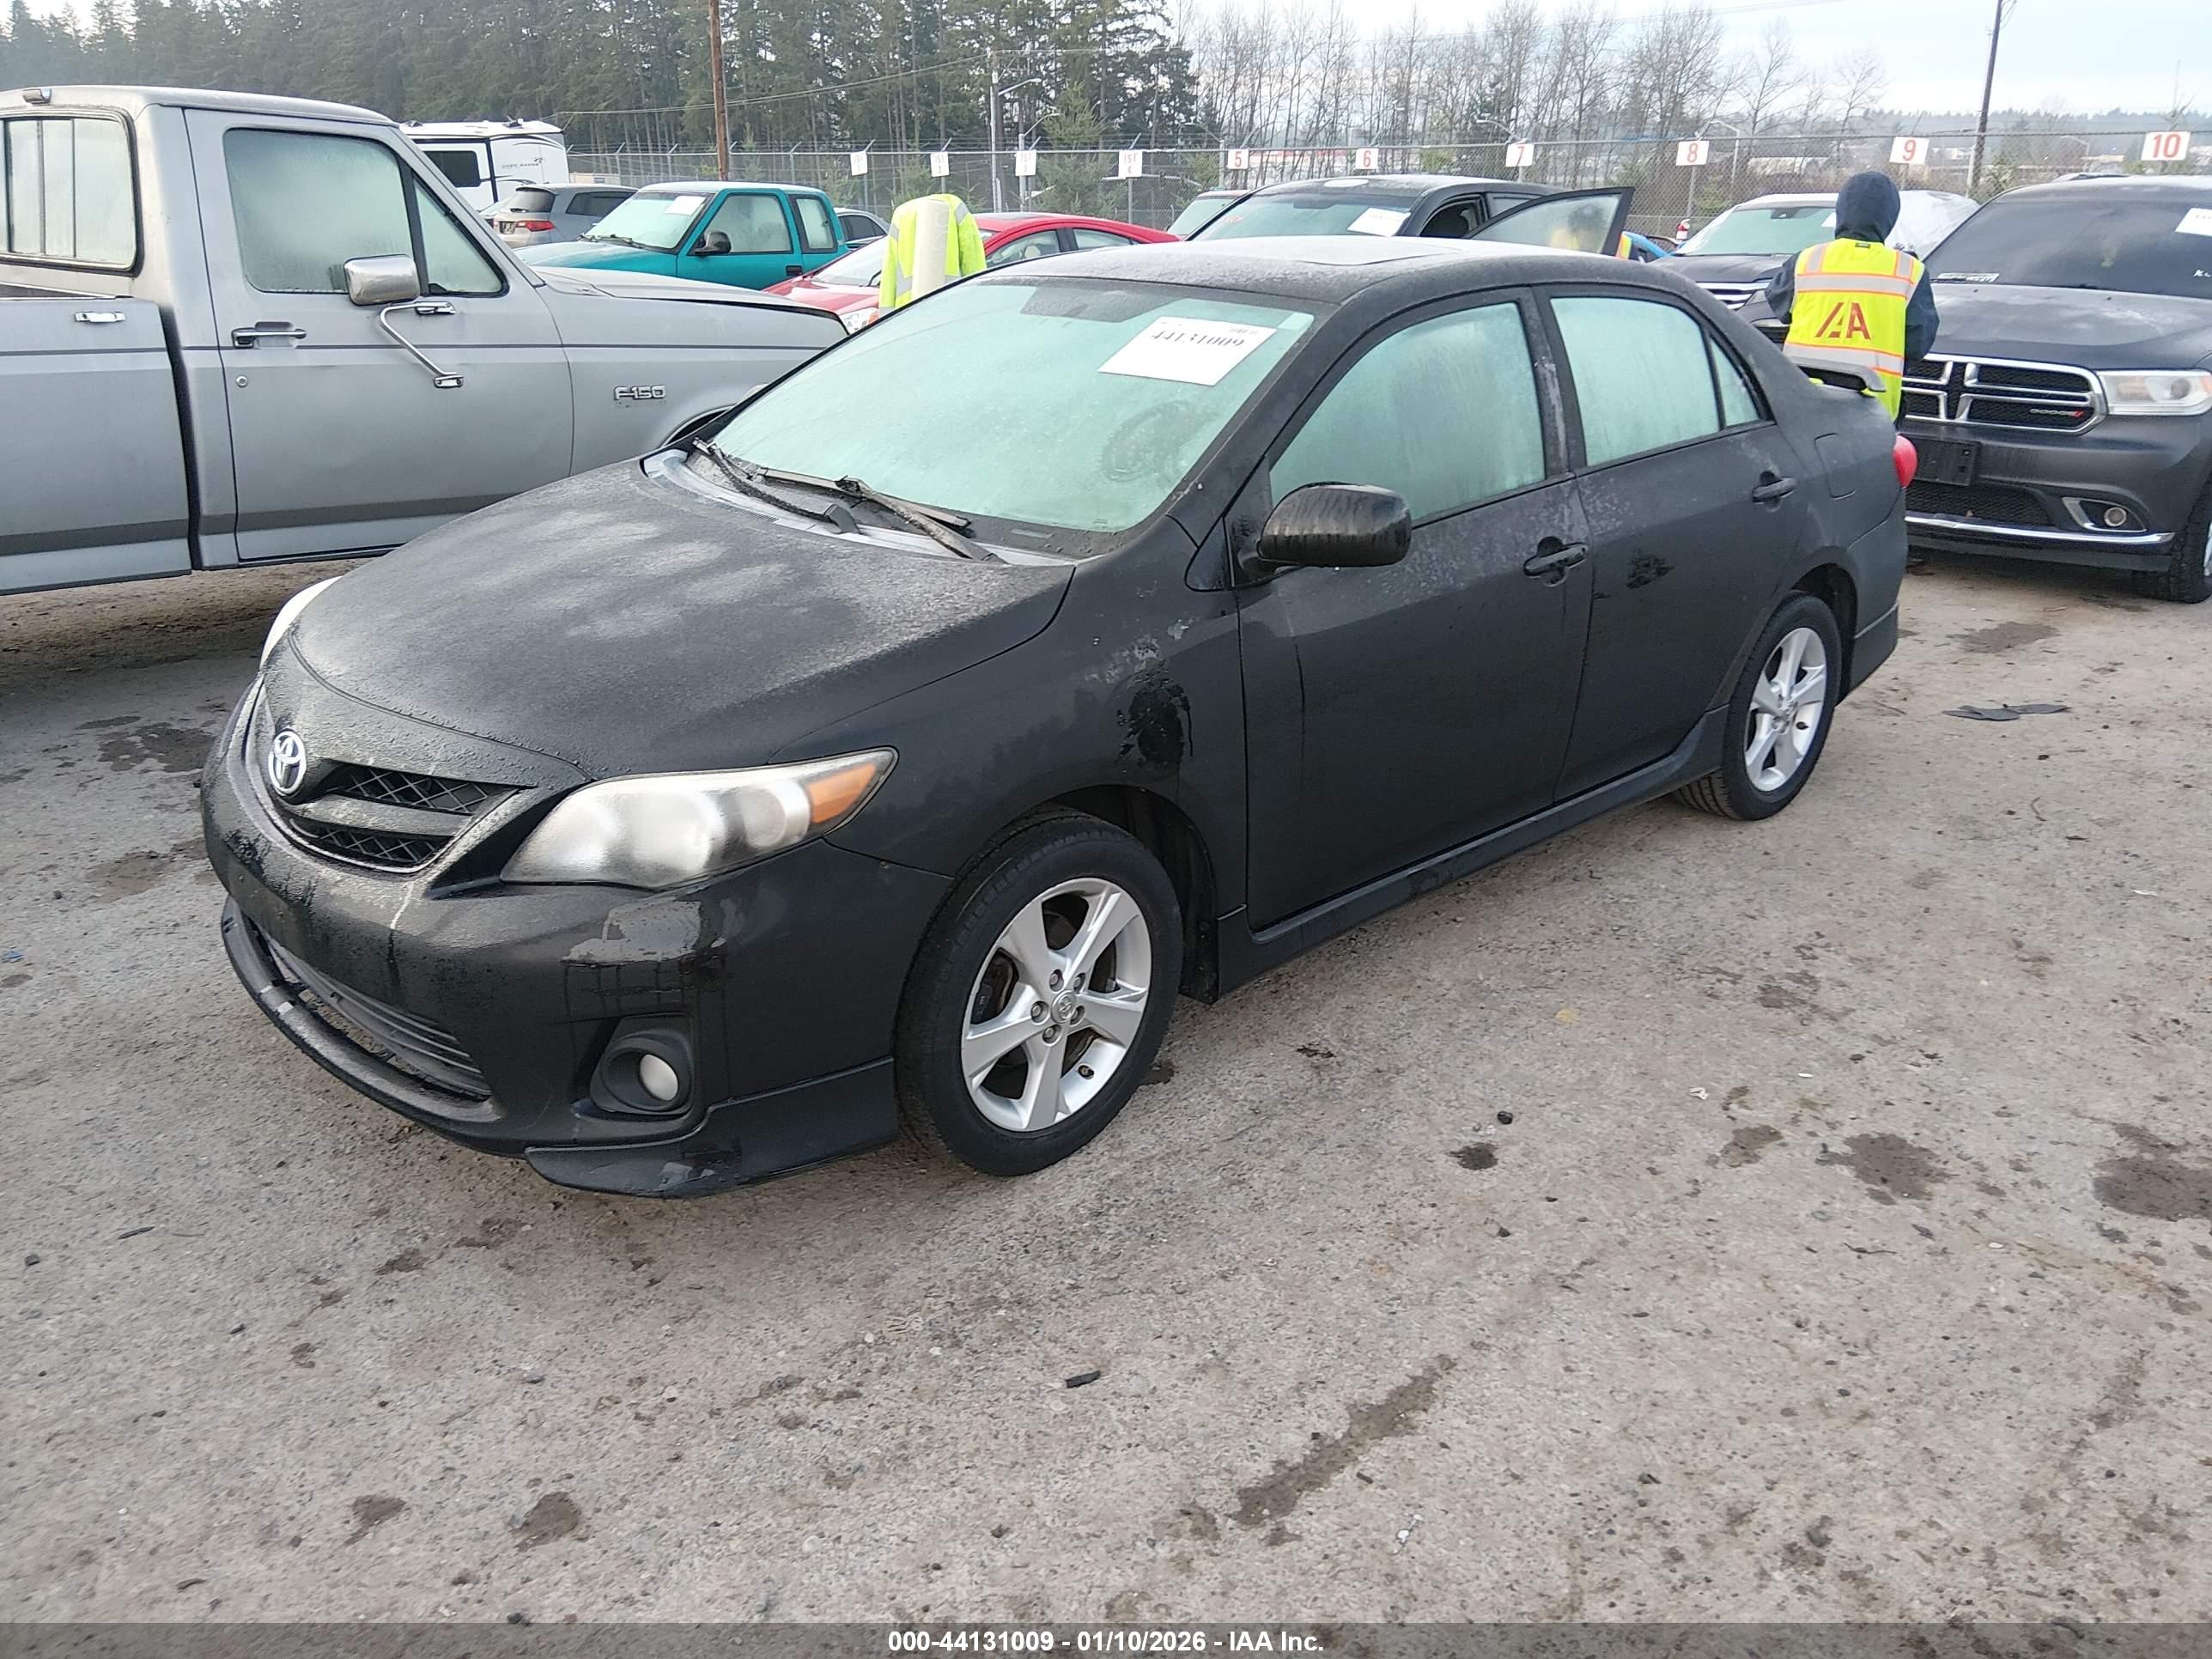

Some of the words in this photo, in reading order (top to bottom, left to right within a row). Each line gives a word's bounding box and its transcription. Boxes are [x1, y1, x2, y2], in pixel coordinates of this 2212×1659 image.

[1686, 142, 1698, 163] 8
[1902, 138, 1917, 161] 9
[2153, 132, 2182, 159] 10
[1234, 150, 1242, 167] 5
[1363, 149, 1371, 167] 6
[1516, 145, 1525, 167] 7
[1151, 330, 1245, 347] 44131009
[613, 384, 667, 401] F-150
